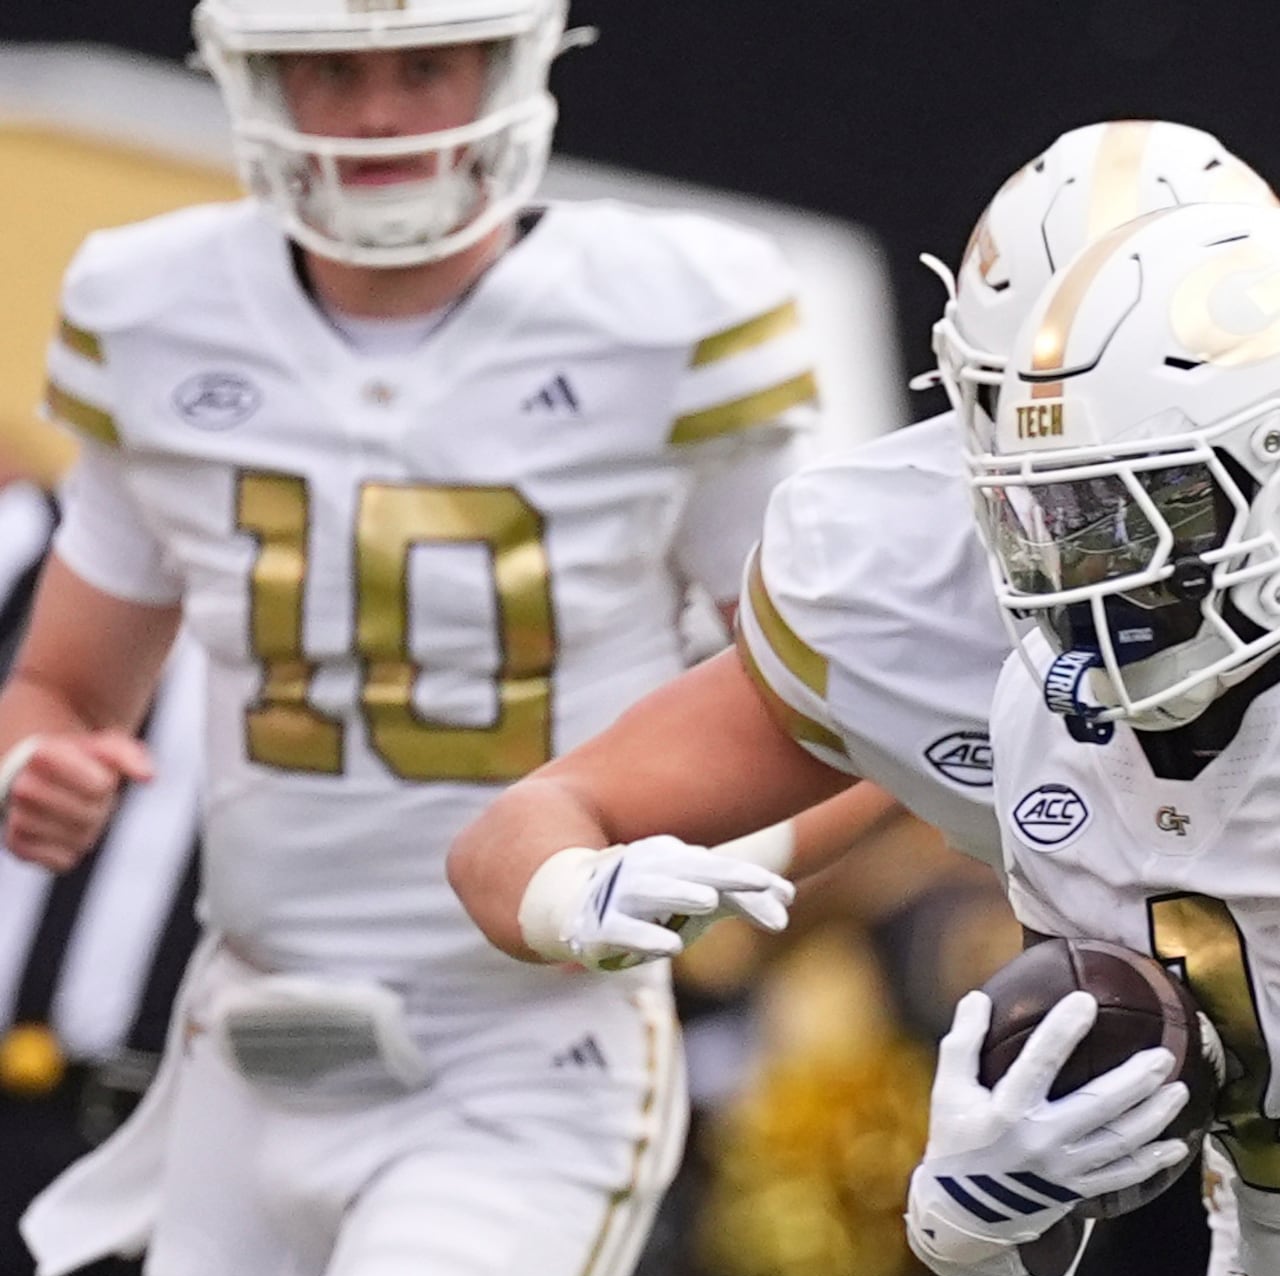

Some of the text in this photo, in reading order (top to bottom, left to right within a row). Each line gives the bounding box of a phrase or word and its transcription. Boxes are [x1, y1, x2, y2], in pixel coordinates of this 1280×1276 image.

[1016, 403, 1064, 439] TECH
[235, 470, 556, 780] 10
[941, 743, 993, 764] AC
[1023, 799, 1080, 819] ACC
